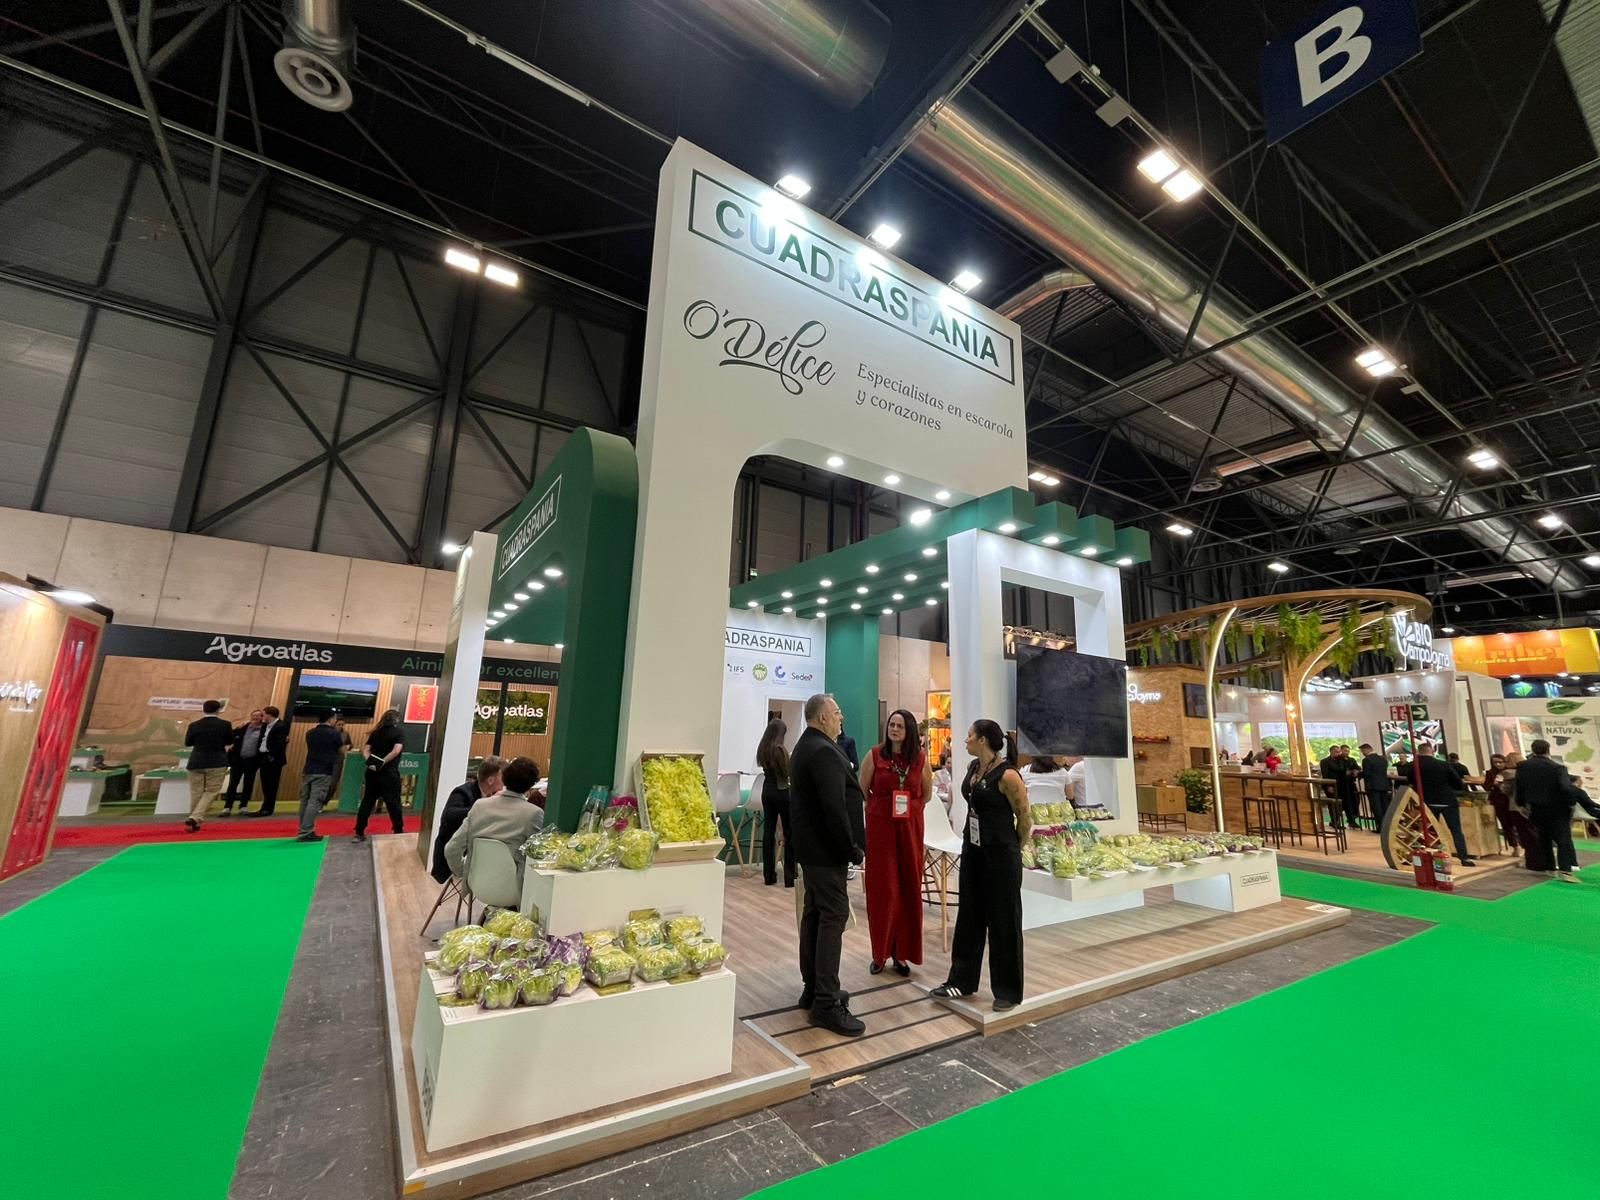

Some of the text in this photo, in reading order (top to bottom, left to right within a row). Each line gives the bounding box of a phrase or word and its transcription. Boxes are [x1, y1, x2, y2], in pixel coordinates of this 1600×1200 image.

[1294, 6, 1372, 107] B
[715, 199, 999, 367] CUADRASPANIA
[684, 300, 835, 395] O'Délice
[855, 389, 942, 431] y corazones
[857, 363, 1013, 439] Especialistas en escarola
[502, 492, 554, 569] CUADRASPANIA
[205, 636, 333, 663] Agroatlas
[725, 631, 804, 653] ADRASPANIA
[1414, 621, 1432, 647] BIO
[401, 656, 442, 672] Aimi
[496, 664, 559, 680] excellen
[1545, 727, 1583, 735] NATURAL
